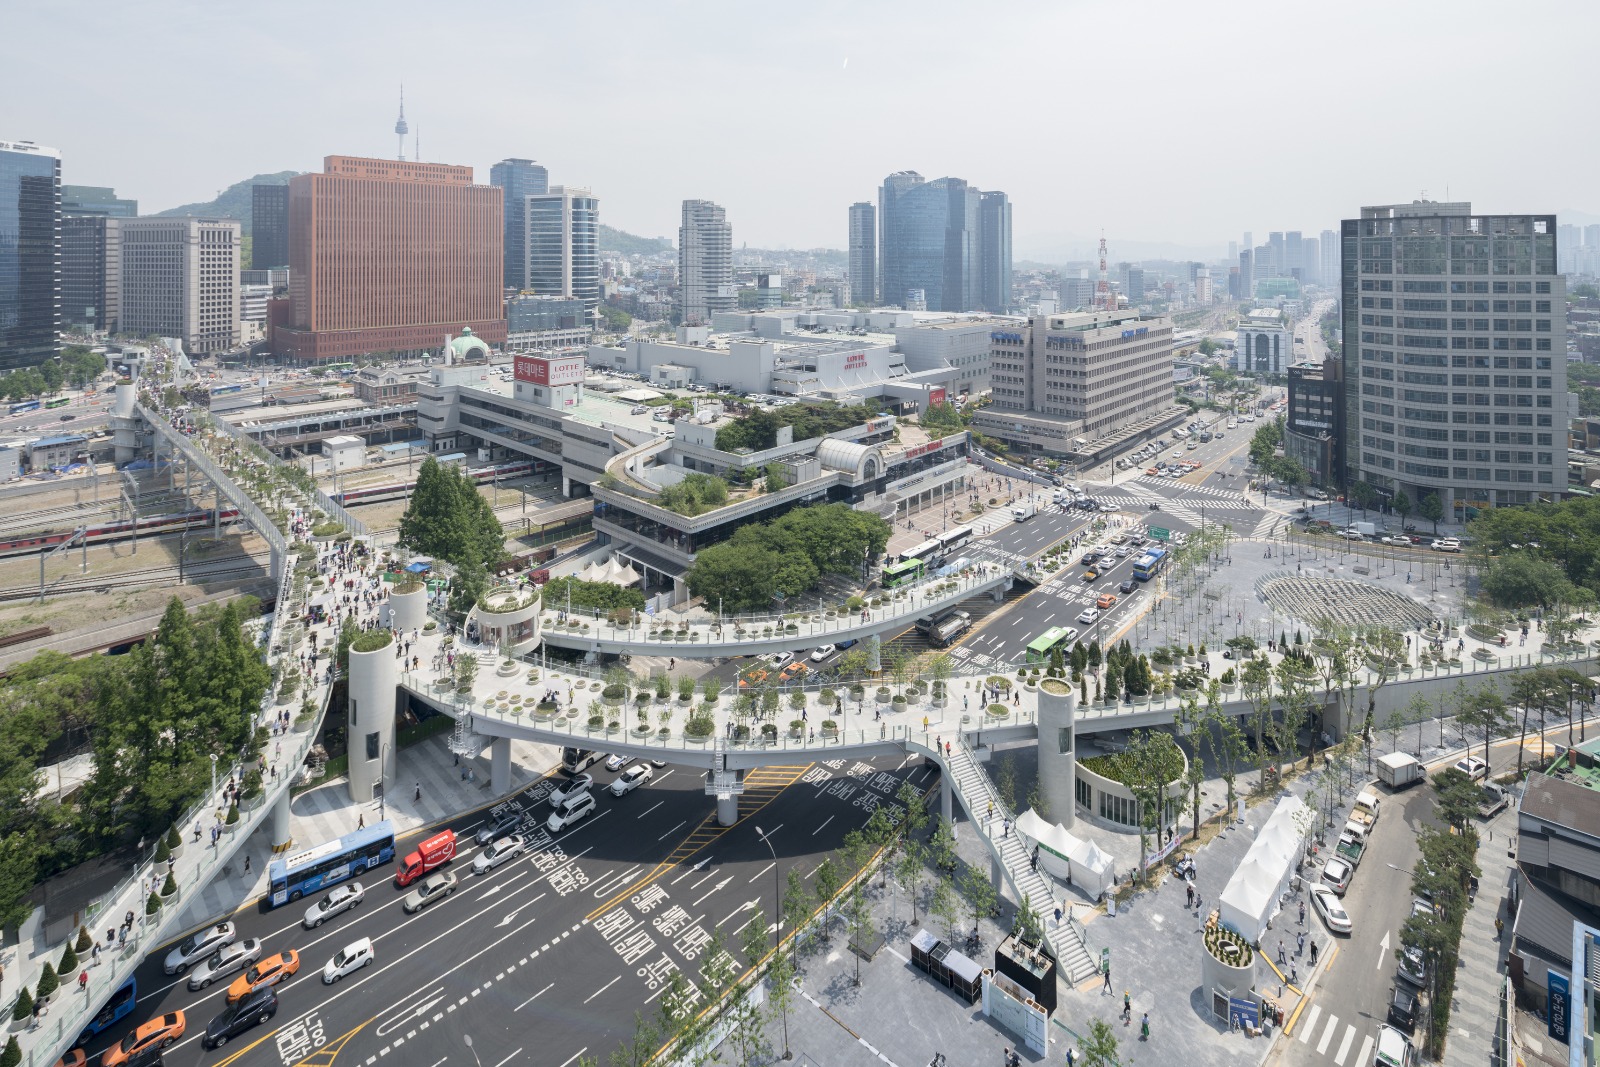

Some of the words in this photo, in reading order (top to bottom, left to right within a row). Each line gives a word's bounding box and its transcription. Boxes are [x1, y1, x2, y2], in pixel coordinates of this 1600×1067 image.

[517, 361, 545, 378] 롯데마트
[551, 371, 583, 379] OUTLETS
[554, 363, 579, 372] LOTTE
[844, 362, 868, 370] OUTLETS
[801, 766, 833, 788] 삼거리
[827, 779, 858, 801] 삼거리
[870, 772, 901, 794] 만리동
[531, 845, 568, 872] 충정로
[547, 862, 589, 897] 충정로역
[631, 883, 671, 914] 청파동
[593, 906, 635, 941] 삼거리
[652, 904, 692, 937] 청파동
[613, 929, 658, 966] 삼거리
[673, 925, 714, 961] 만리동
[636, 952, 680, 990] 공덕동
[1552, 993, 1565, 1036] 우리은행
[274, 1011, 327, 1066] 충정로역
